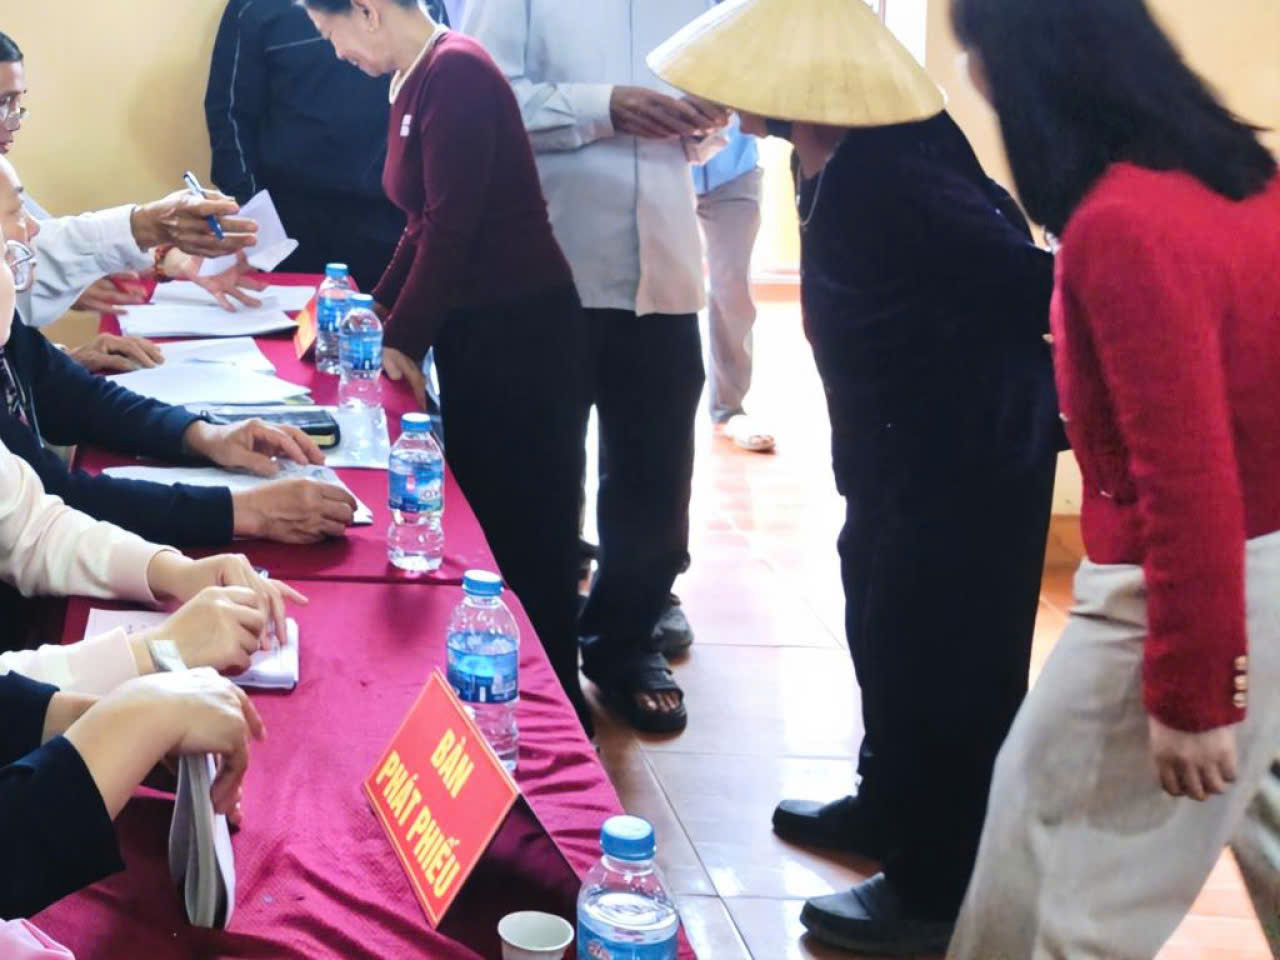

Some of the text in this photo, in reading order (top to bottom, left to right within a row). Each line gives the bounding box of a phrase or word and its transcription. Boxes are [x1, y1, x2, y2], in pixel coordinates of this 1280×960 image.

[430, 728, 475, 798] BÀN
[376, 749, 460, 898] PHÁT PHIẾU
